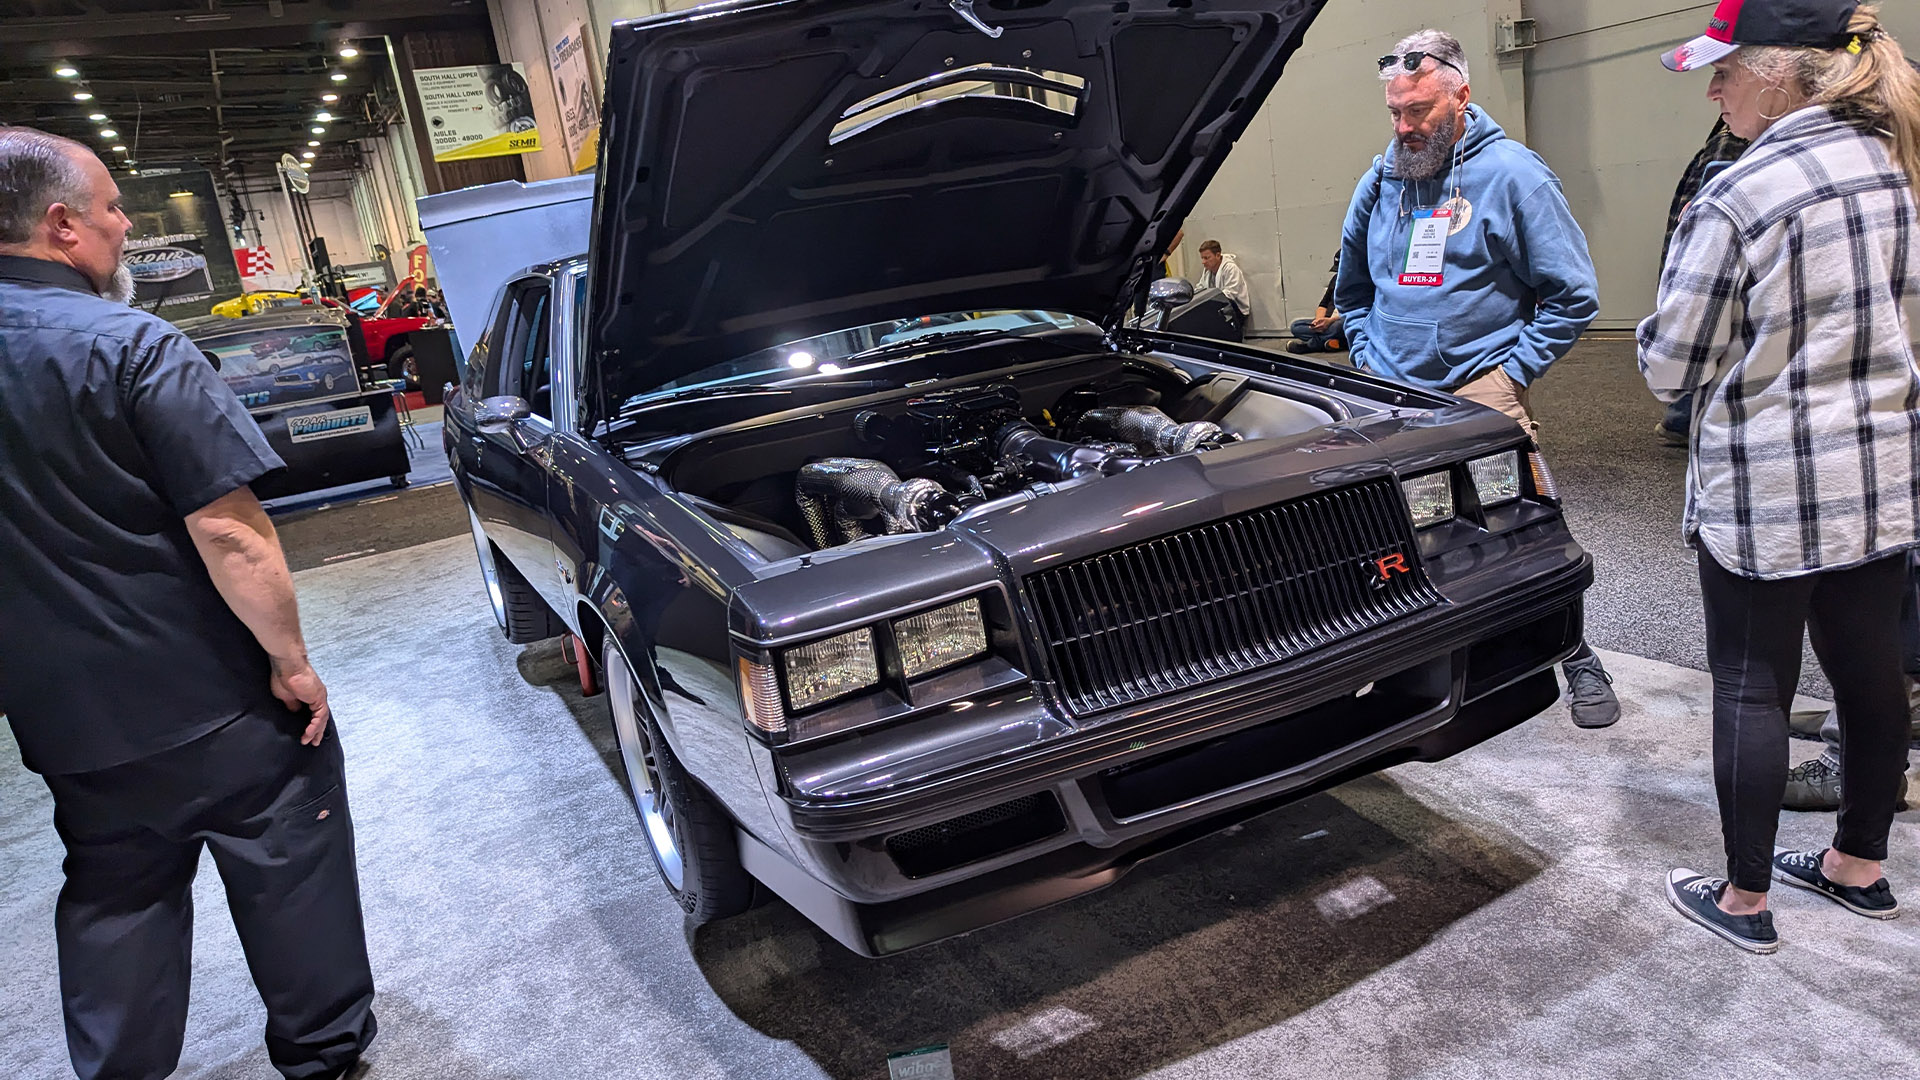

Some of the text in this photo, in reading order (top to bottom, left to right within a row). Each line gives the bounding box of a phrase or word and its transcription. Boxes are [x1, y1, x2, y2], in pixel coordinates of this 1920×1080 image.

[434, 129, 457, 137] AISLES
[435, 137, 457, 145] 30000
[509, 138, 536, 148] SEMA
[155, 250, 185, 262] AIR
[1403, 275, 1437, 283] BUYER-24
[290, 415, 327, 428] OLD AIR
[292, 413, 369, 436] PRODUCTS
